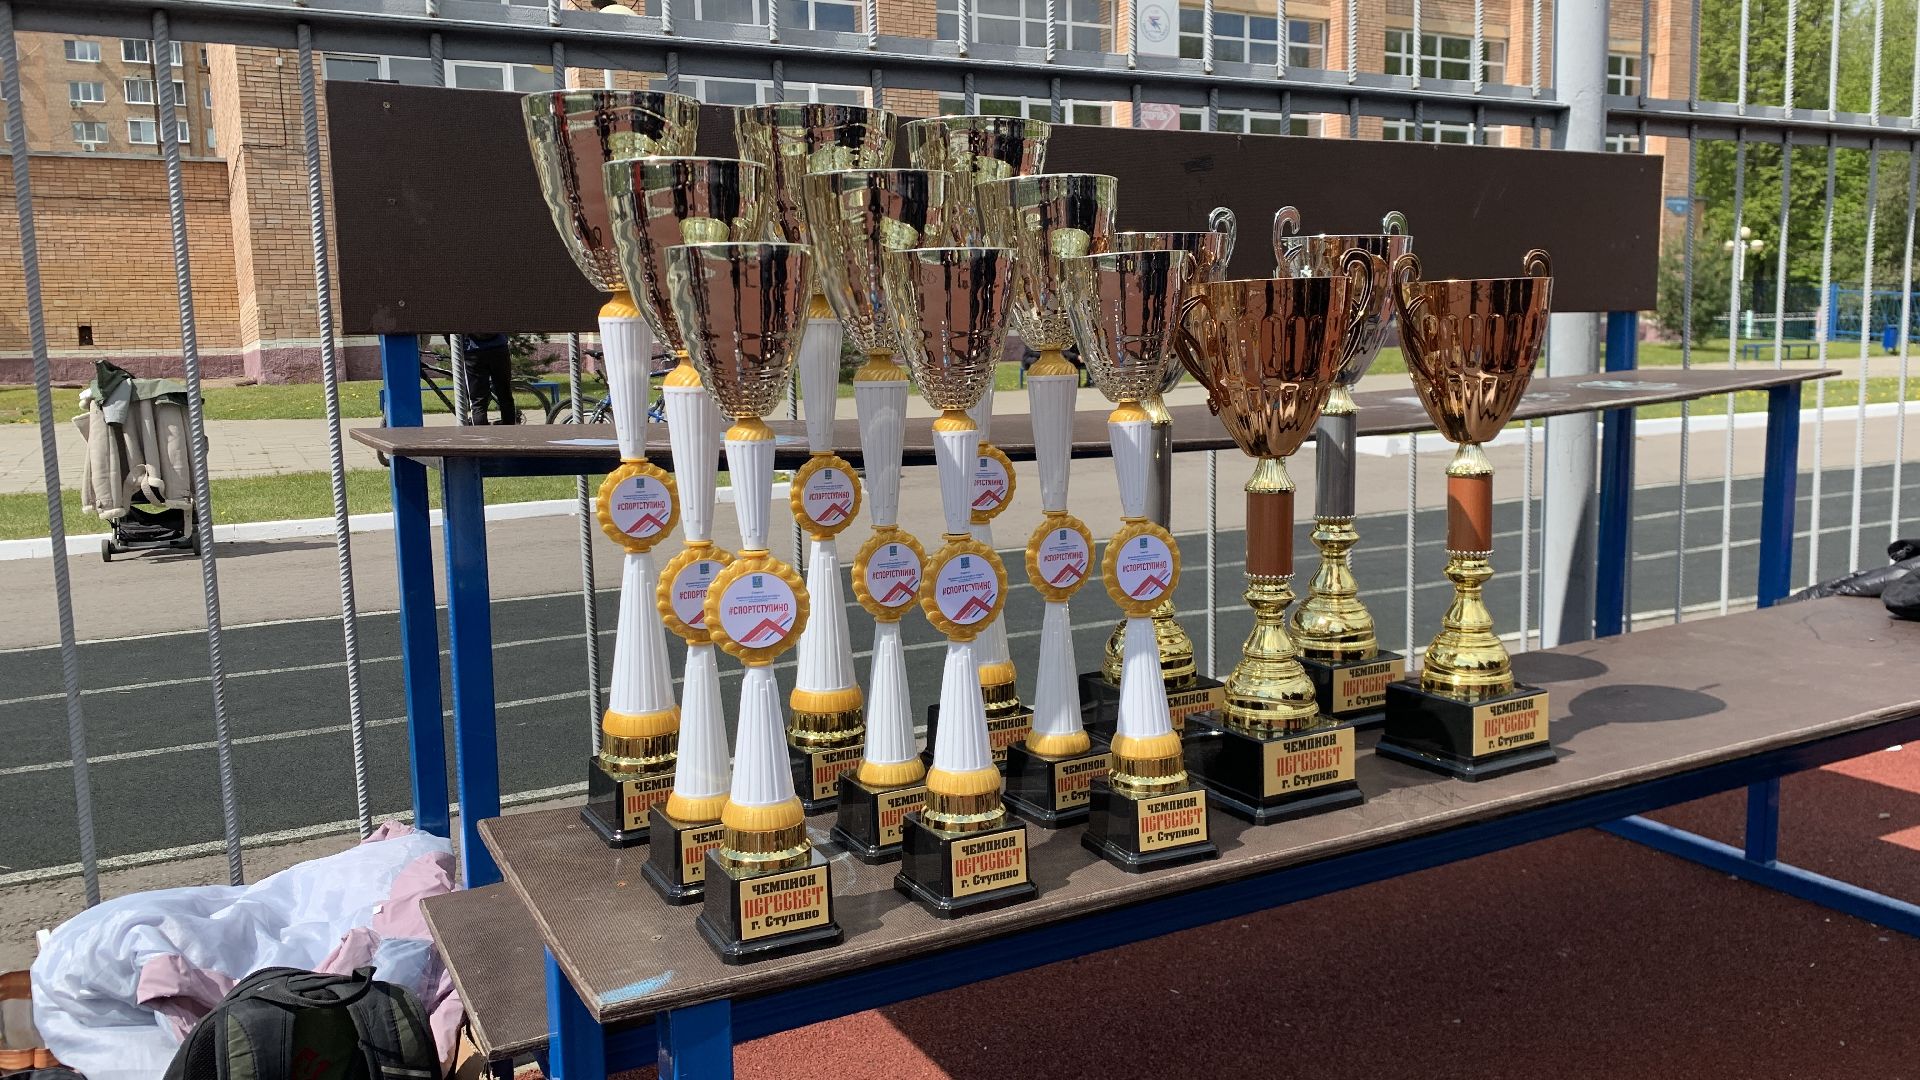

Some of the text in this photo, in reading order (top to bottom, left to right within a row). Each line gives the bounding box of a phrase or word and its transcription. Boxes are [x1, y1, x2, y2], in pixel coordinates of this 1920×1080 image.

[617, 501, 666, 511] #СПОРТСТУПИНО
[872, 568, 916, 580] #СПОРТСТУПИНО
[1122, 561, 1167, 573] #СПОРТСТУПИНО
[680, 590, 707, 600] #СПОРТС
[942, 580, 992, 595] #СПОРТСТУПИНО
[729, 603, 789, 615] #СПОРТСТУПИНО
[1350, 663, 1391, 678] ЧЕМПИОН
[1167, 692, 1209, 708] ЕМПИОН
[1490, 699, 1534, 716] ЧЕМПИОН
[987, 717, 1027, 731] ЕМПИОН
[1484, 710, 1539, 738] ПЕРЕСВЕТ
[1283, 734, 1337, 753] ЧЕМПИОН
[1498, 732, 1535, 747] Ступино
[1062, 759, 1106, 775] ЧЕМПИОН
[1277, 746, 1343, 777] ПЕРЕСВЕТ
[1282, 770, 1338, 789] г. Ступино
[887, 792, 926, 808] ЧЕМПИ
[1147, 797, 1197, 813] ЧЕМПИОН
[1141, 808, 1203, 833] ПЕРЕСВЕТ
[692, 829, 724, 844] ЧЕМП
[1146, 828, 1199, 843] г. Ступино
[961, 836, 1016, 855] ЧЕМПИОН
[955, 847, 1022, 877] ПЕРЕСВЕТ
[752, 874, 816, 895] ЧЕМПИОН
[961, 869, 1018, 888] г. Ступино
[744, 886, 823, 919] ПЕРЕСВЕТ
[751, 910, 819, 930] г. Ступино
